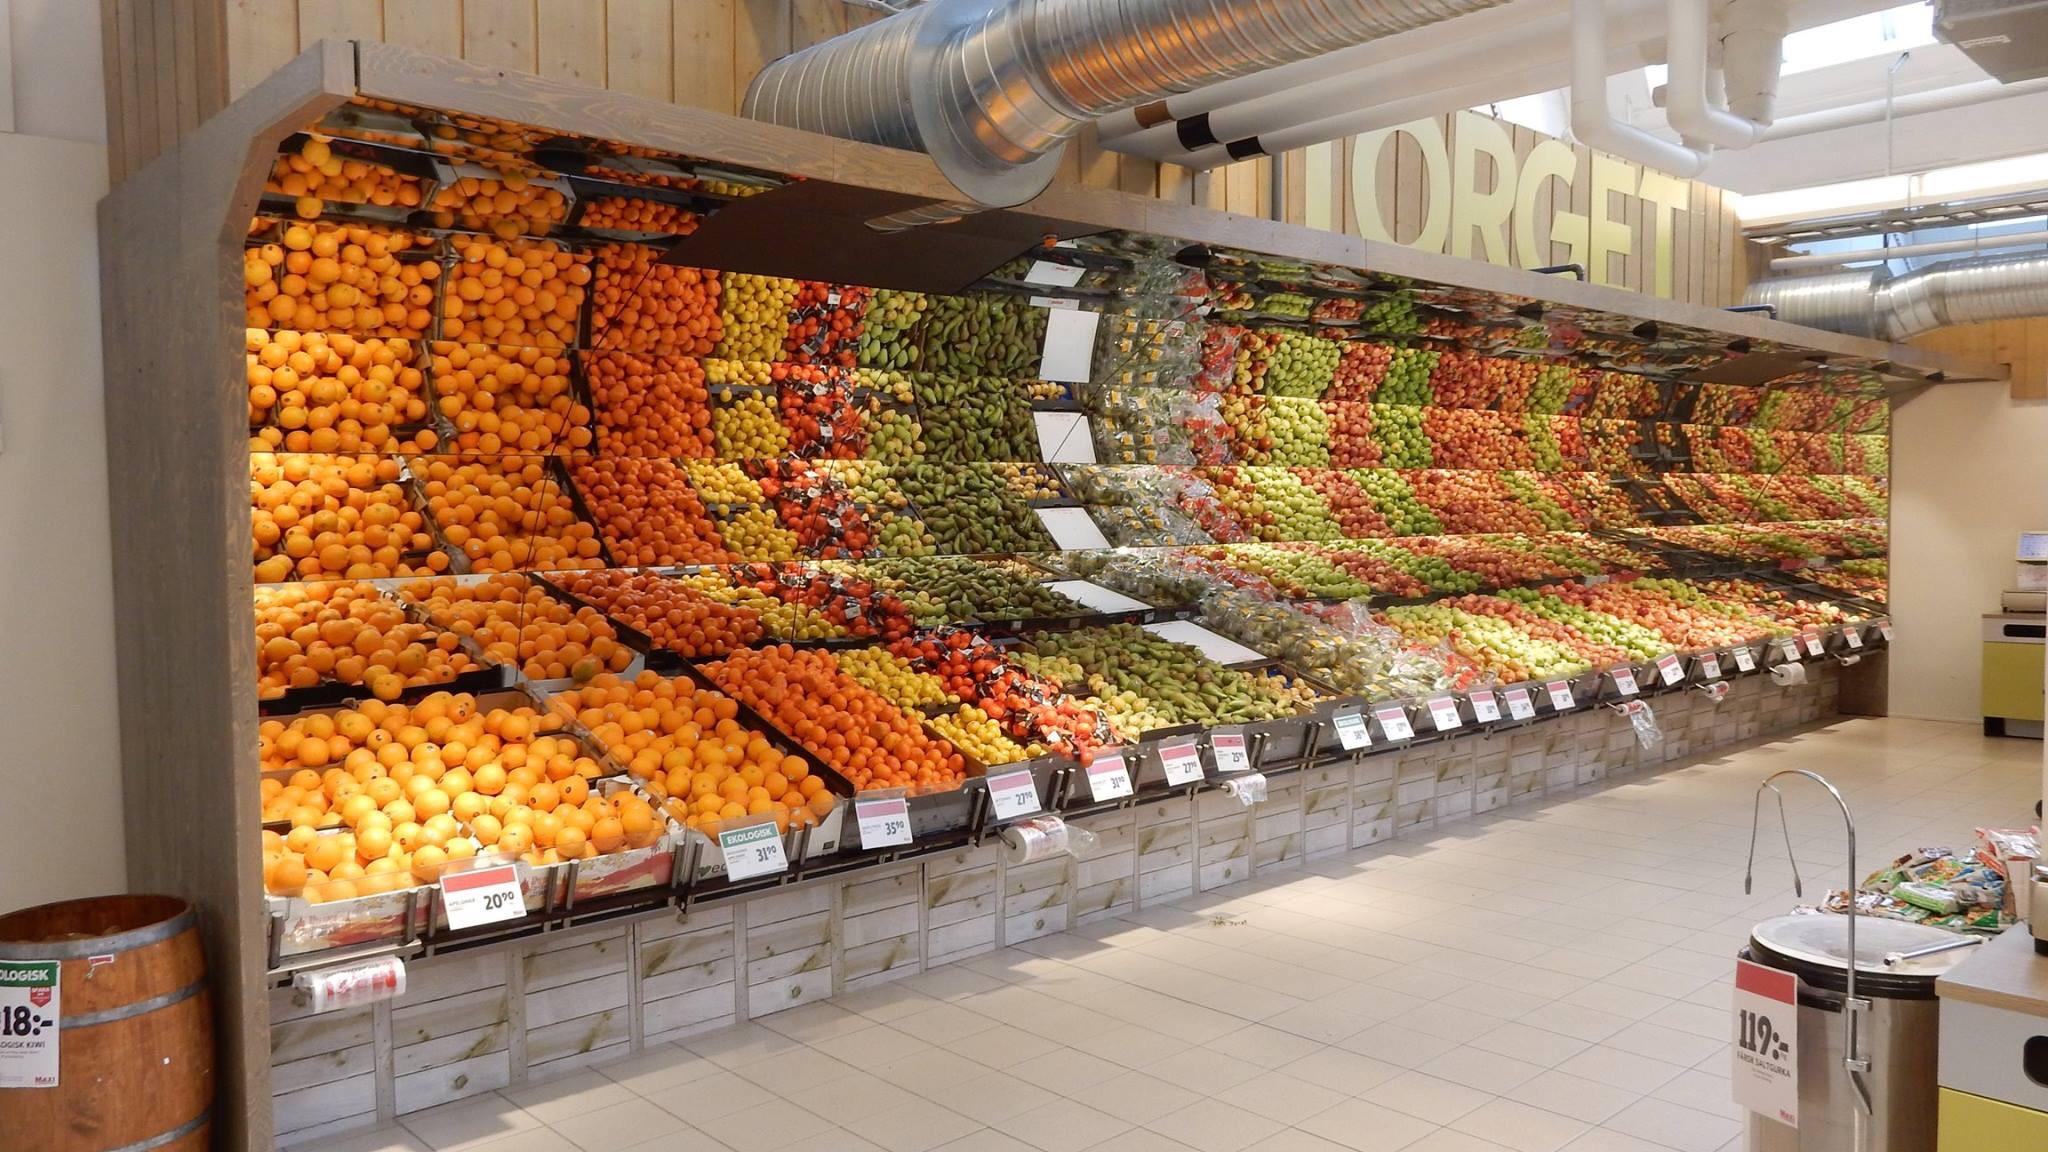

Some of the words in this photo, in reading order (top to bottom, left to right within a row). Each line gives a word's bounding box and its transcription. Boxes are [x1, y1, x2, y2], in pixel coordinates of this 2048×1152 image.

[727, 828, 772, 845] EKOLOGISK
[0, 1006, 53, 1036] 18:-
[1754, 1056, 1791, 1078] SALTGURKA
